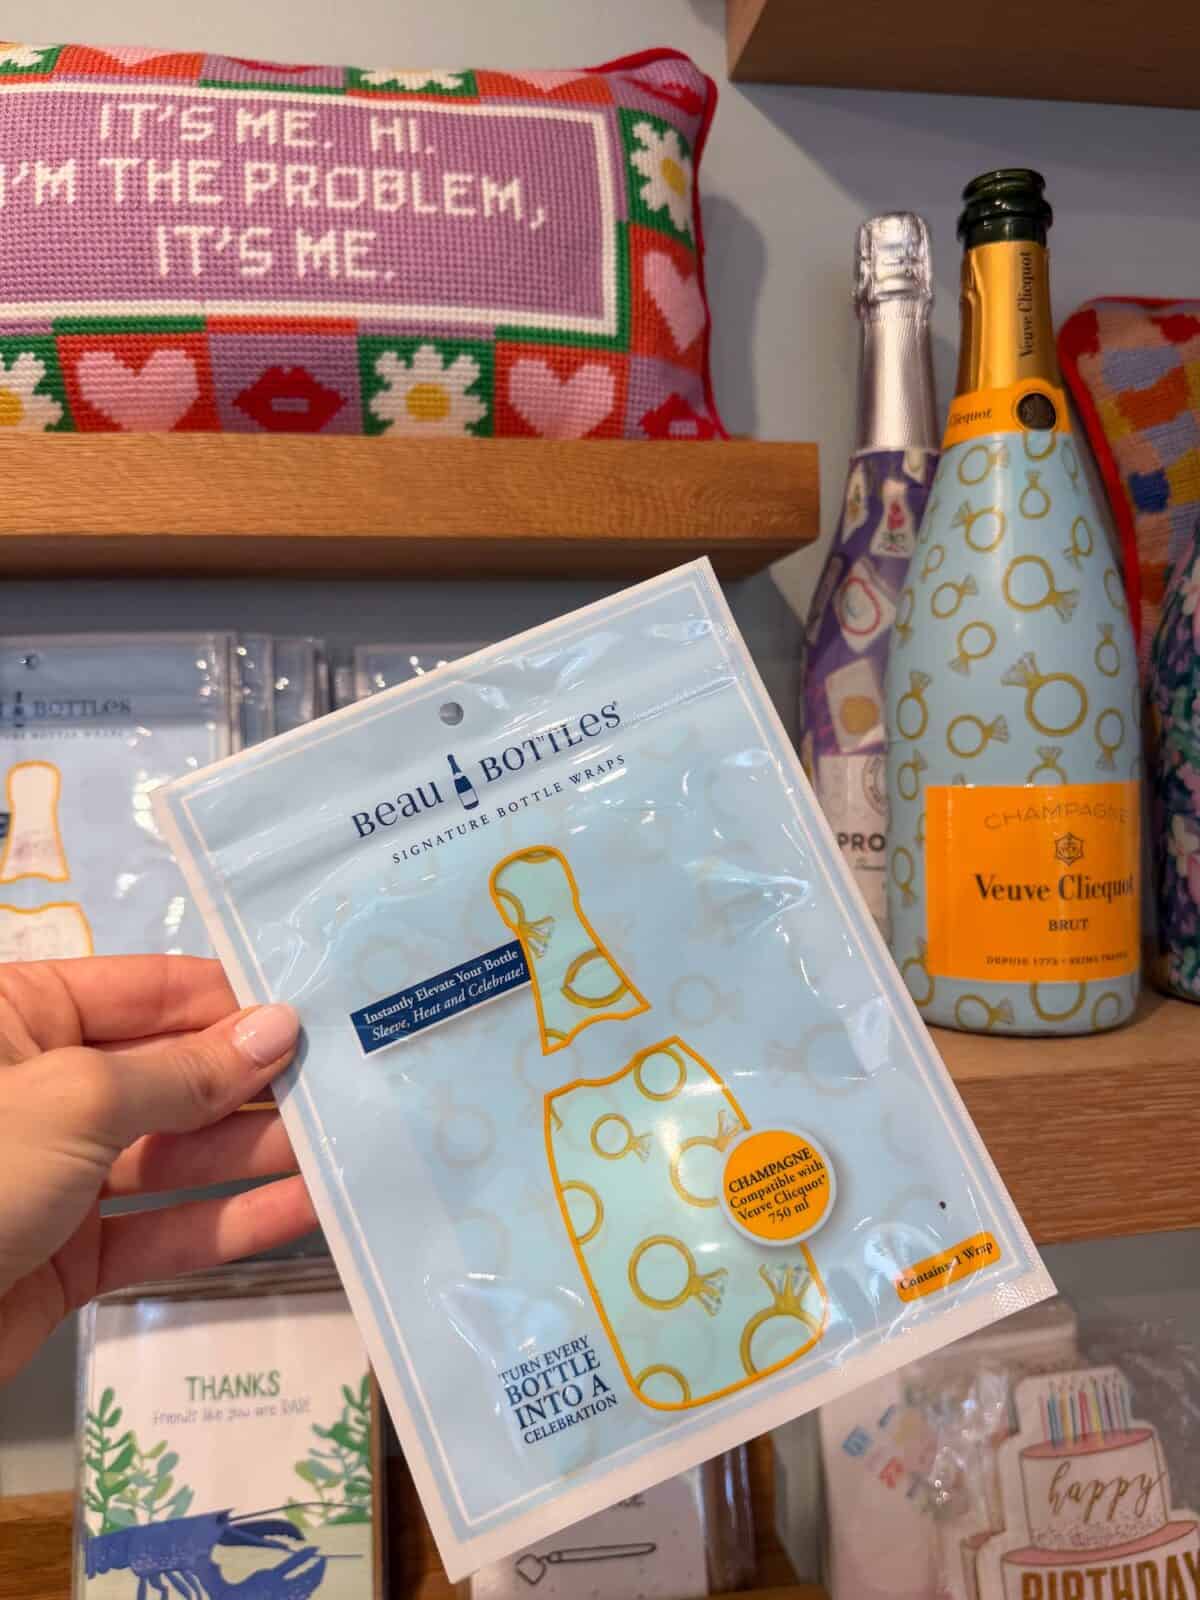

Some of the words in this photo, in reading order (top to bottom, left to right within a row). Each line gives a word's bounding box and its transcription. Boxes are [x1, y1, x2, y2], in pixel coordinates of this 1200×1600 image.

[100, 103, 217, 142] IT'S
[236, 107, 334, 149] ME.
[370, 116, 435, 154] HI.
[98, 158, 224, 205] THE
[243, 161, 546, 231] PROBLEM,
[157, 225, 273, 278] IT'S
[295, 227, 395, 281] ME.
[391, 814, 490, 865] SIGNATURE
[496, 780, 564, 818] BOTTLE
[569, 754, 626, 786] WRAPS
[975, 873, 1051, 902] Veuve
[1047, 917, 1089, 932] BRUT
[363, 996, 414, 1025] Instantly
[415, 976, 457, 1003] Elevate
[455, 966, 484, 985] Your
[484, 949, 519, 972] Bottle
[371, 1018, 411, 1042] Sleeve,
[412, 1002, 443, 1024] Heat
[443, 989, 467, 1010] and
[467, 962, 526, 999] Celebrate!
[728, 1146, 814, 1193] CHAMPAGNE
[730, 1174, 796, 1209] Compatible
[797, 1159, 825, 1178] with
[737, 1201, 773, 1220] Veuve
[767, 1206, 792, 1225] 750
[794, 1197, 810, 1214] ml
[961, 1241, 994, 1260] Wrap
[498, 1356, 542, 1384] TURN
[543, 1335, 592, 1366] EVERY
[504, 1349, 601, 1407] BOTTLE
[184, 1369, 281, 1402] THANKS
[514, 1384, 584, 1430] INTO
[592, 1373, 612, 1398] A
[524, 1394, 619, 1444] CELEBRATION
[1047, 1460, 1164, 1524] happy
